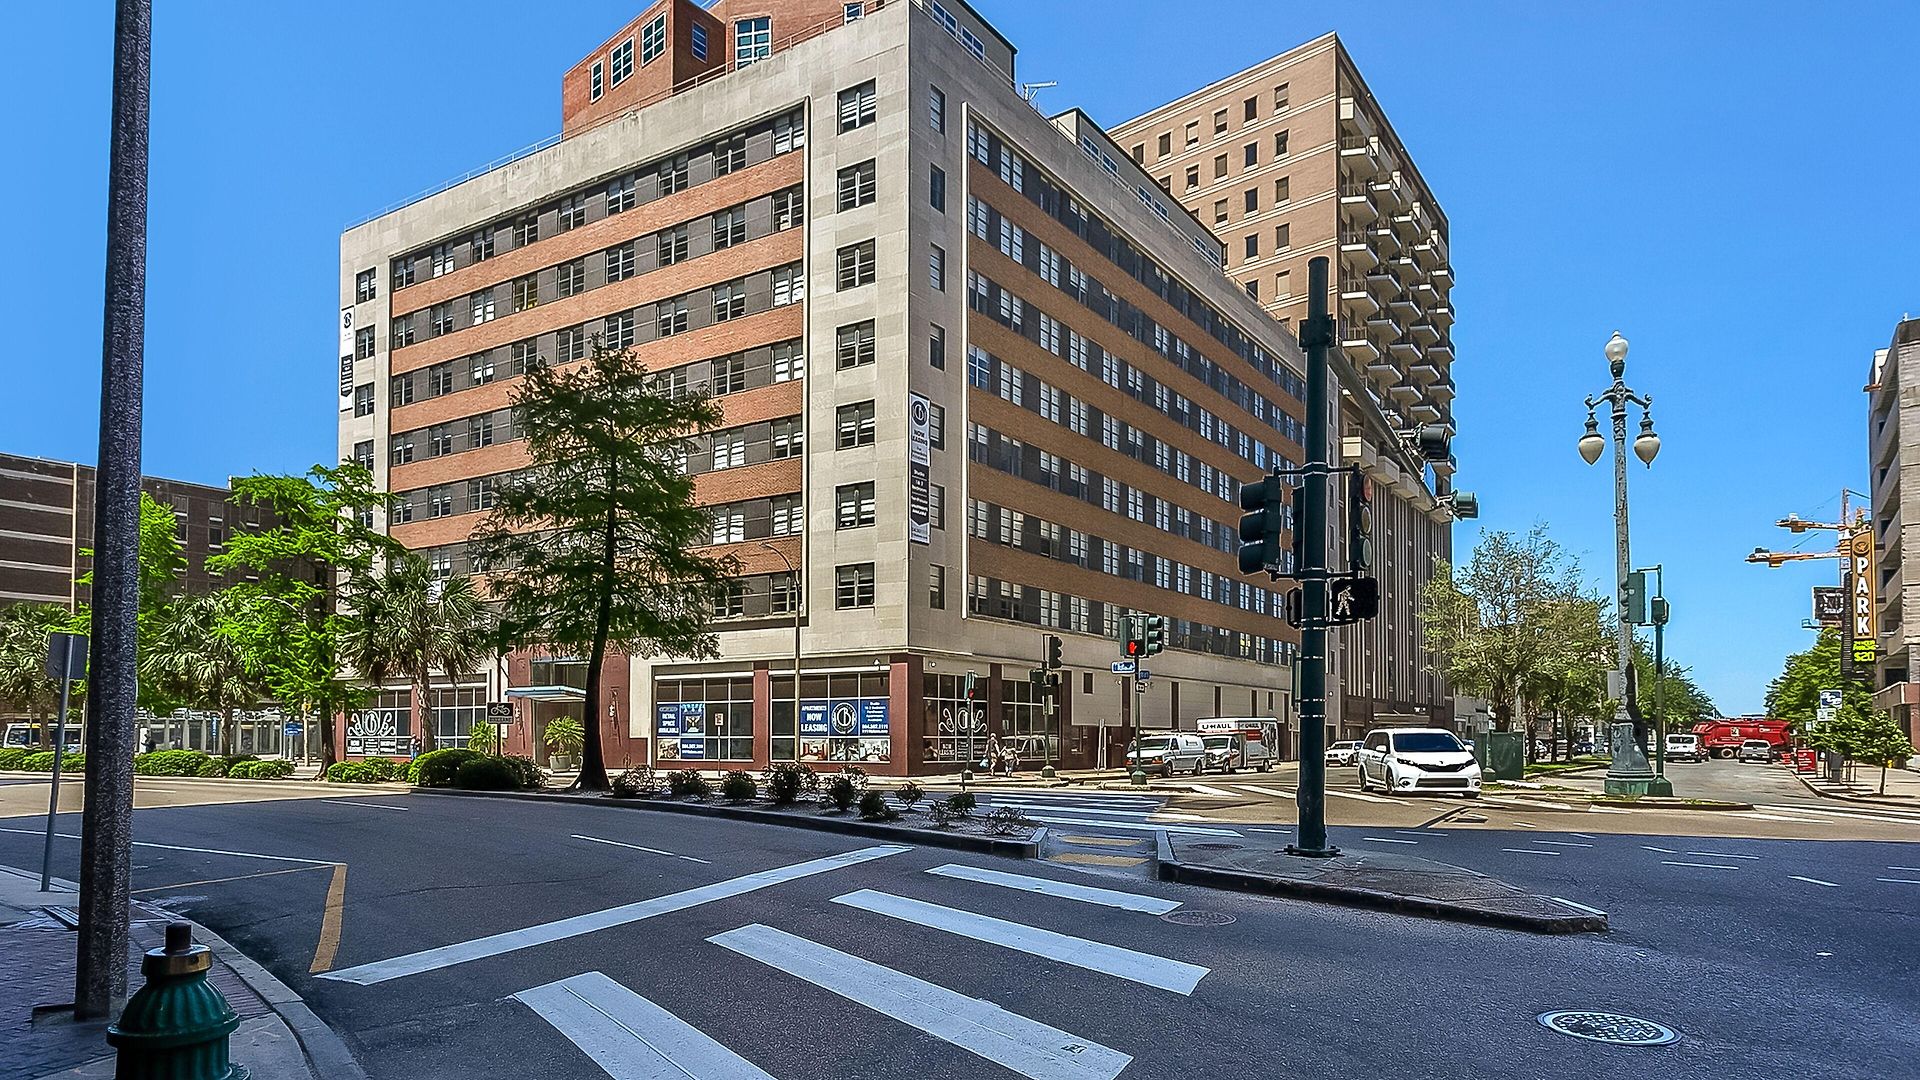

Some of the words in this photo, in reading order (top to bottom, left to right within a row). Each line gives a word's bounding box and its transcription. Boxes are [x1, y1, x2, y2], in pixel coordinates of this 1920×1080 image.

[1856, 556, 1870, 634] PARK
[1854, 651, 1875, 661] $20
[806, 713, 823, 721] NOW
[800, 723, 828, 732] LEASING
